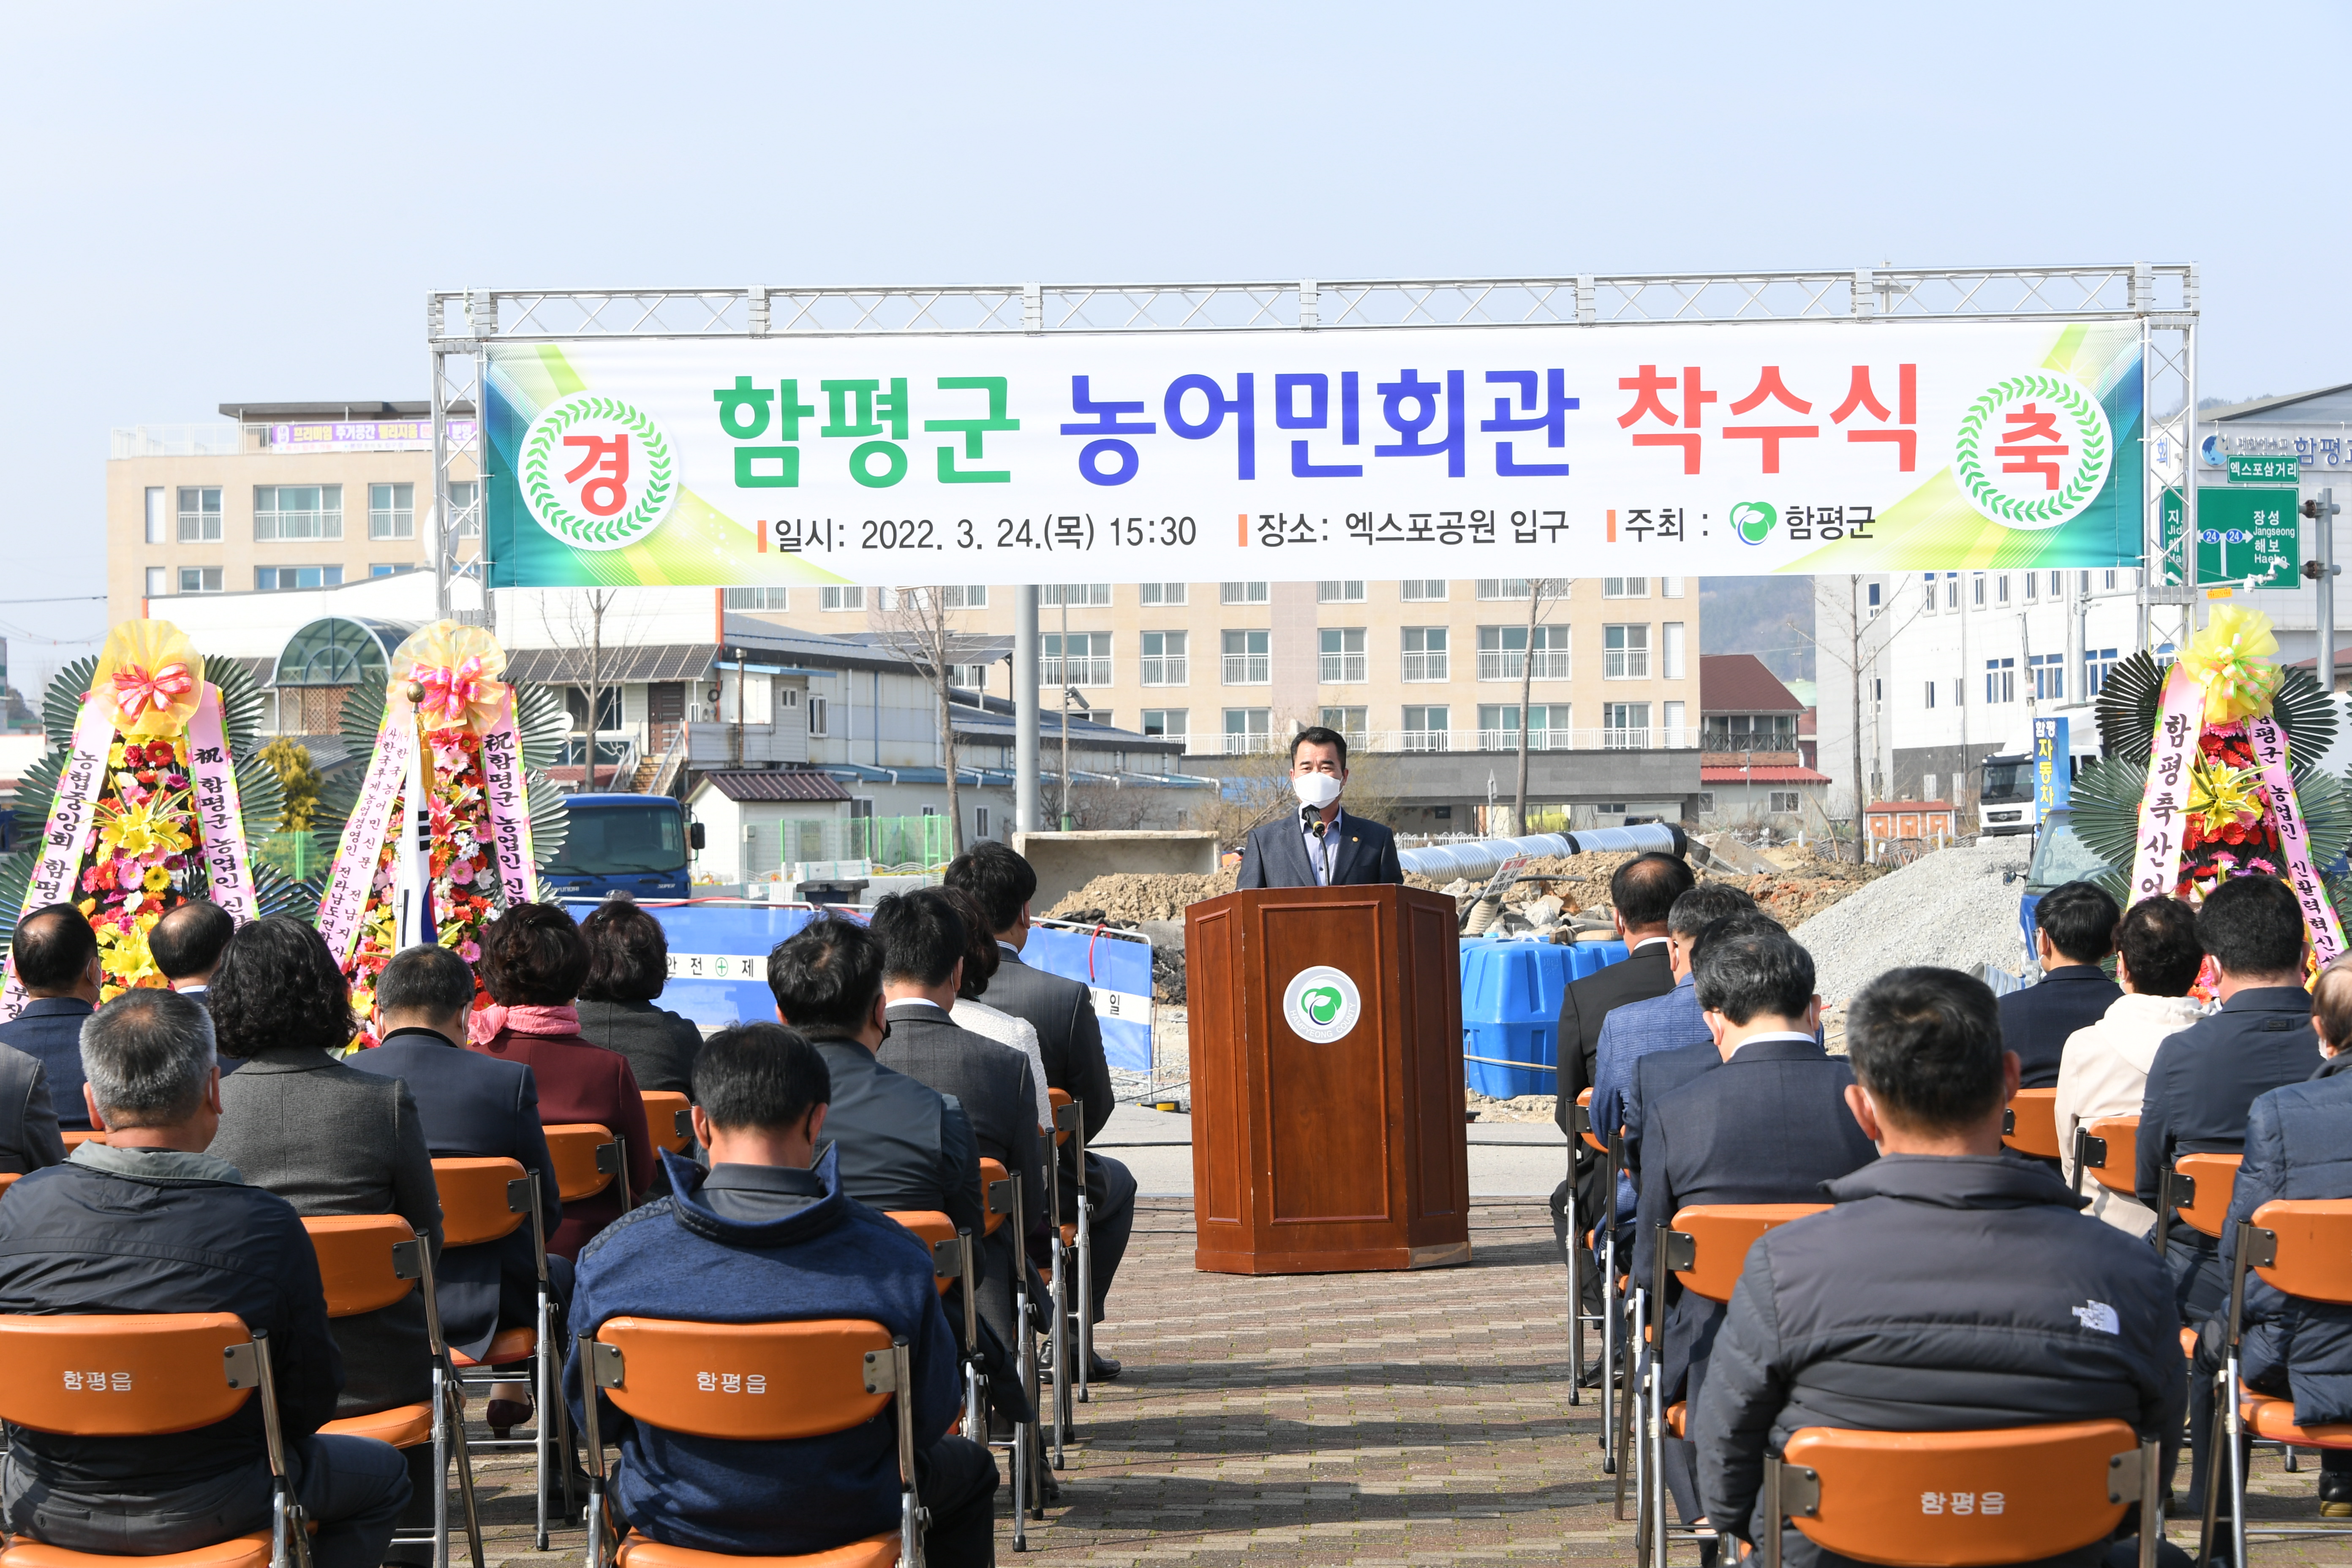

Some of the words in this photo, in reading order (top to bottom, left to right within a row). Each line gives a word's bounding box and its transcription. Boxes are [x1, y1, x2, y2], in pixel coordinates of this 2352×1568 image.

[294, 425, 332, 442] 프리미엄
[336, 424, 376, 440] 주거공간
[713, 376, 1020, 488] 함평군
[1060, 368, 1580, 486] 농어민회관
[1617, 363, 1917, 475] 착수식
[1995, 402, 2069, 490] 축
[564, 434, 629, 516] 경
[2230, 461, 2297, 477] 엑스포삼거리
[2167, 509, 2183, 524] 지
[776, 518, 845, 553] 일시:
[862, 520, 943, 551] 2022.
[957, 519, 983, 550] 3.
[997, 514, 1094, 552] 24.(목)
[1111, 516, 1197, 547] 15:30
[1258, 513, 1328, 548] 장소:
[1346, 510, 1496, 546] 엑스포공원
[1511, 509, 1570, 544] 입구
[1786, 506, 1876, 541] 함평군
[2167, 525, 2182, 535] Jid
[2206, 531, 2216, 542] 24
[2230, 531, 2240, 542] 24
[2253, 525, 2295, 538] Jangseong
[2035, 720, 2055, 738] 함평
[193, 747, 224, 764] 祝
[47, 750, 99, 851] 농협중앙회
[198, 776, 233, 830] 함평군
[2270, 784, 2298, 840] 농업인
[493, 815, 521, 870] 농업인
[208, 838, 237, 889] 농업인
[29, 858, 71, 909] 함평
[1487, 881, 1514, 893] 야적장
[1290, 1010, 1333, 1038] HAMPYEONG
[1336, 1002, 1356, 1033] COUNTY
[63, 1371, 133, 1392] 함평읍
[697, 1371, 767, 1394] 함평읍
[1920, 1492, 2006, 1515] 함평읍
